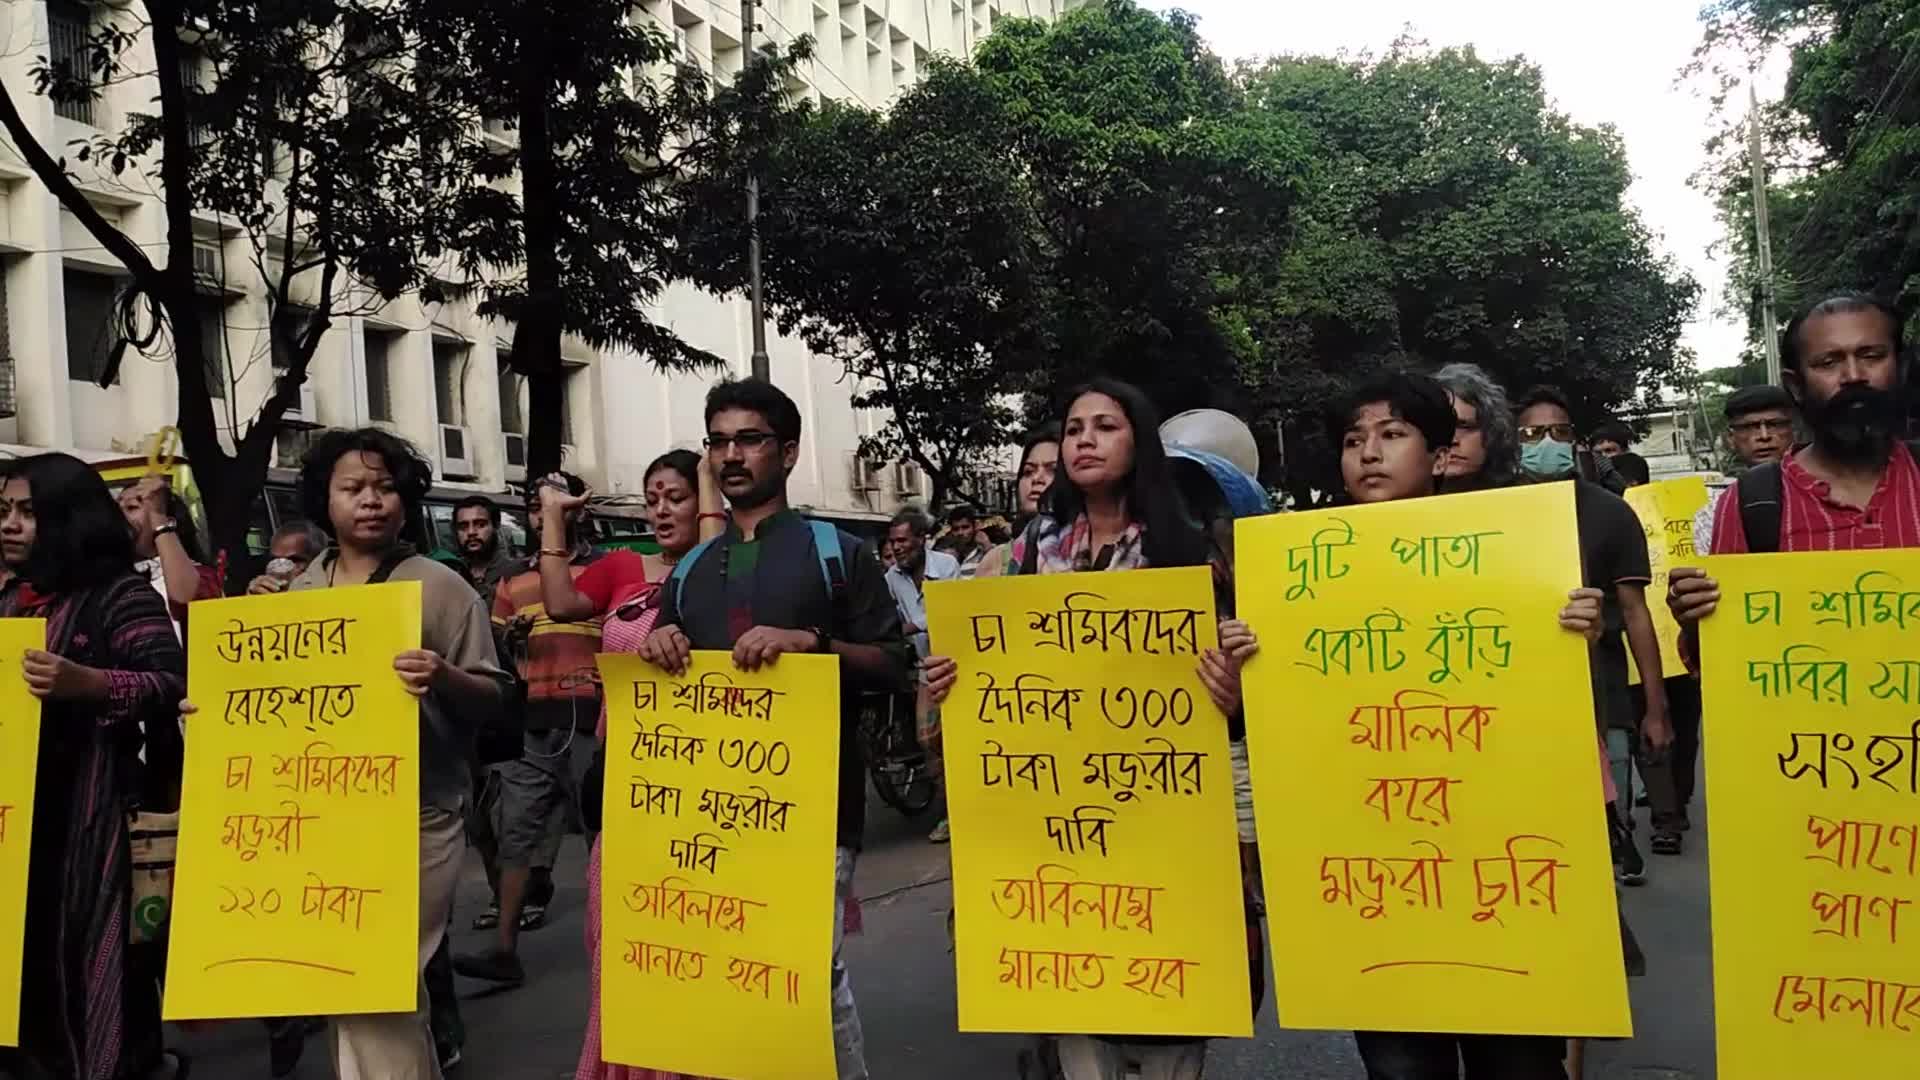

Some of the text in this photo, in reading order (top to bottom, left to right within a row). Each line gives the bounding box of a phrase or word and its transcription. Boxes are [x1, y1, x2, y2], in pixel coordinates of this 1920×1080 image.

[1285, 517, 1504, 601] দুটি পাতা
[970, 592, 1206, 656] চা শ্রমিকদের
[1744, 591, 1782, 625] চা
[216, 617, 357, 664] উন্নয়নের
[1295, 608, 1512, 684] একটি কুঁড়ি
[632, 680, 656, 711] চা
[976, 672, 1194, 732] দৈনিক ৩০০
[1747, 644, 1848, 706] দাবির
[631, 710, 791, 776] দৈনিক ৩০০
[1349, 689, 1497, 752] মালিক
[227, 742, 403, 796] চা শ্রমিকদের
[980, 740, 1061, 796] টাকা
[630, 776, 682, 817] টাকা
[1365, 777, 1462, 826] করে
[668, 828, 732, 874] দাবি
[1044, 804, 1116, 858] দাবি
[220, 872, 381, 929] ১২০ টাকা
[624, 876, 767, 933] অবিলম্বে
[992, 864, 1164, 934] অবিলম্বে
[1472, 834, 1571, 927] চুরি
[1811, 890, 1912, 944] প্রাণ
[624, 941, 707, 981] মানতে
[999, 947, 1200, 998] মানতে হবে
